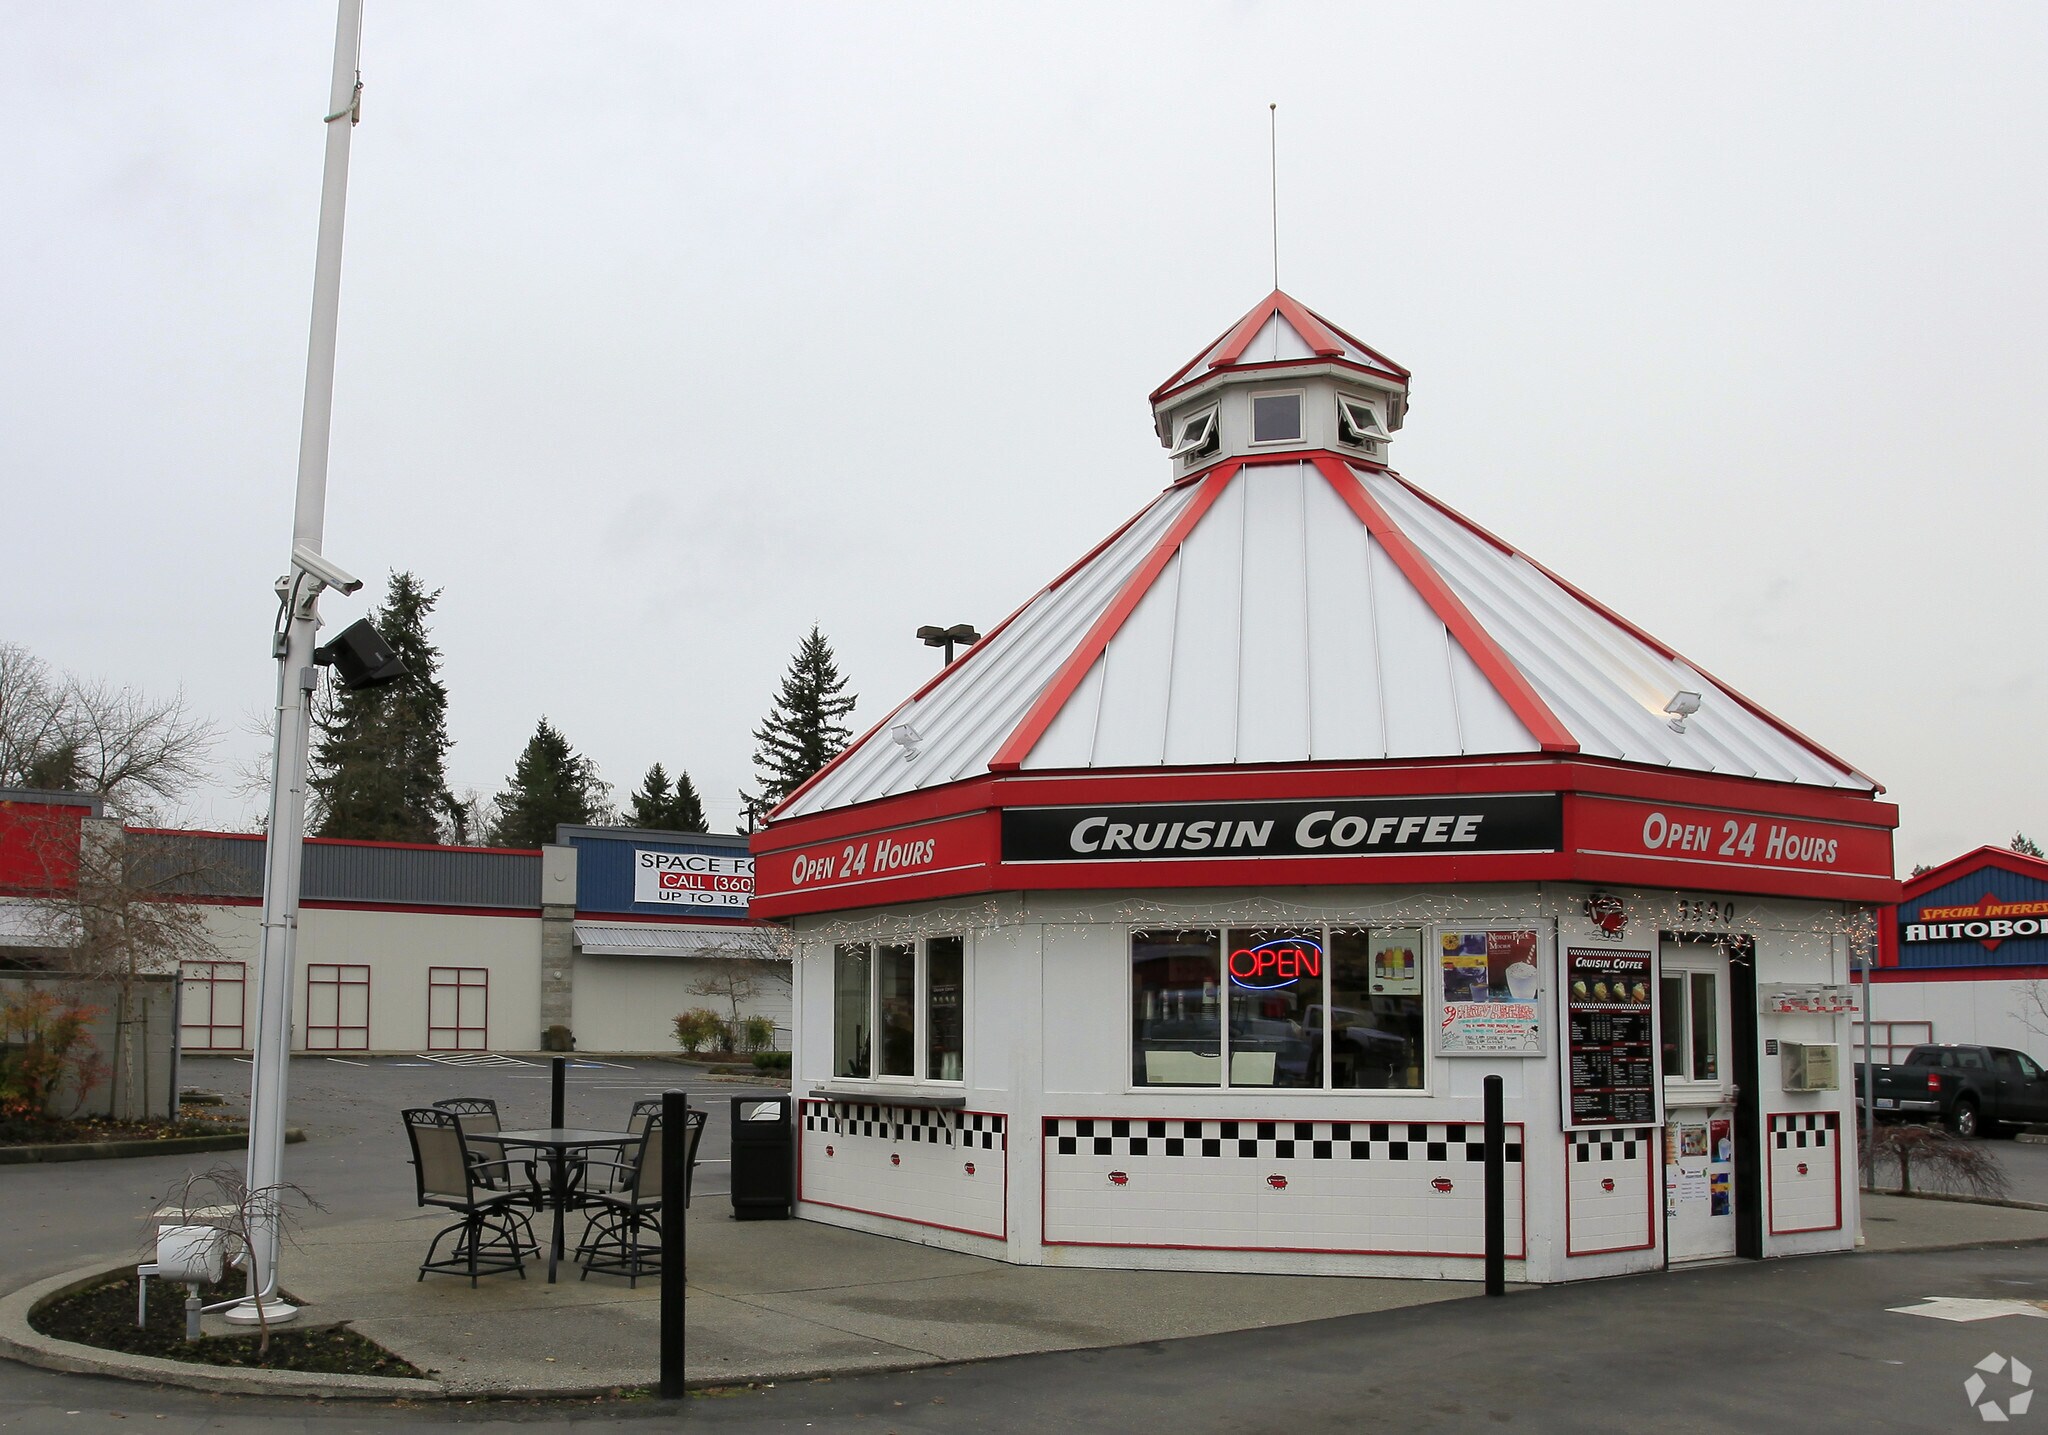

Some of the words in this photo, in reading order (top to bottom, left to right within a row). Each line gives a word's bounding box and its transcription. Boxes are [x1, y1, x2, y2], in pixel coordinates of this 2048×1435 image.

[1069, 816, 1275, 853] CRUISIN
[1295, 810, 1484, 849] COFFEE
[1642, 812, 1711, 852] OPEN
[1718, 820, 1758, 857] 24
[1765, 825, 1838, 864] HOURS
[640, 853, 720, 873] SPACE
[792, 854, 836, 885] OPEN
[838, 844, 870, 879] 24
[872, 838, 936, 869] HOURS
[663, 874, 706, 889] CALL
[659, 891, 682, 901] UP
[689, 893, 714, 903] TO
[1921, 907, 1981, 921] SPECIAL
[1229, 948, 1320, 977] OPEN
[1575, 957, 1611, 969] CRUISIN
[1613, 958, 1643, 970] COFFEE
